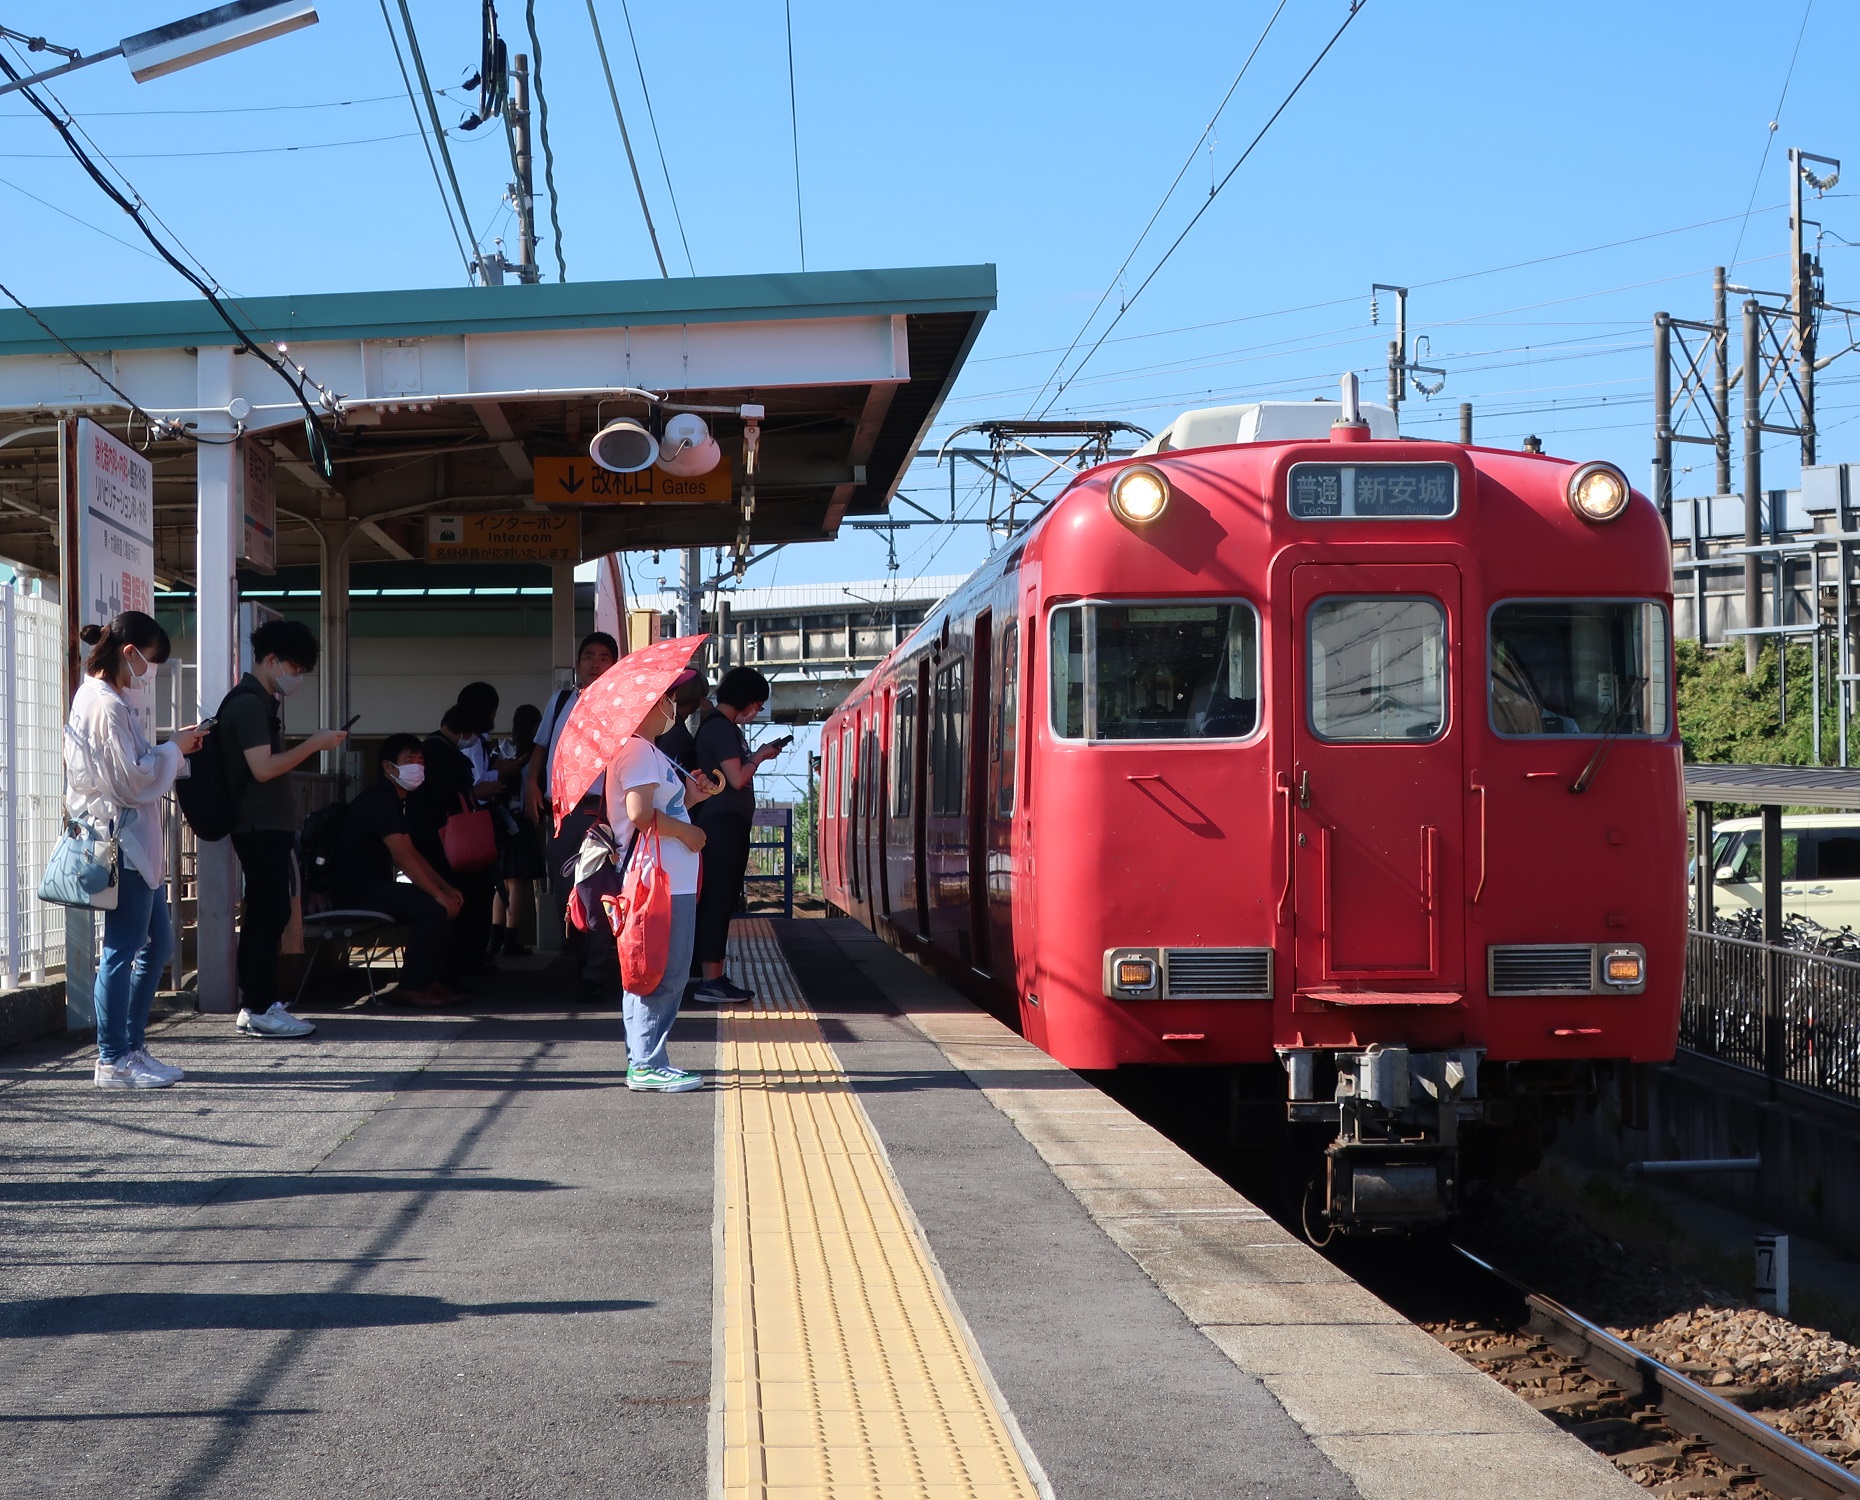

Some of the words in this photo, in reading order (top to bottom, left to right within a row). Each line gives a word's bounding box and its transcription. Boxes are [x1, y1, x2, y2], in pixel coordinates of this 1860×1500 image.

[591, 465, 653, 495] 改札口
[662, 479, 706, 495] Gates
[1297, 475, 1338, 504] 普通
[1358, 475, 1447, 504] 新安城
[1303, 505, 1331, 515] Local
[474, 515, 568, 530] インターホン
[488, 532, 552, 543] Intercom
[434, 547, 572, 560] 名鉄係員が応対いたします
[1757, 1249, 1774, 1283] 7
